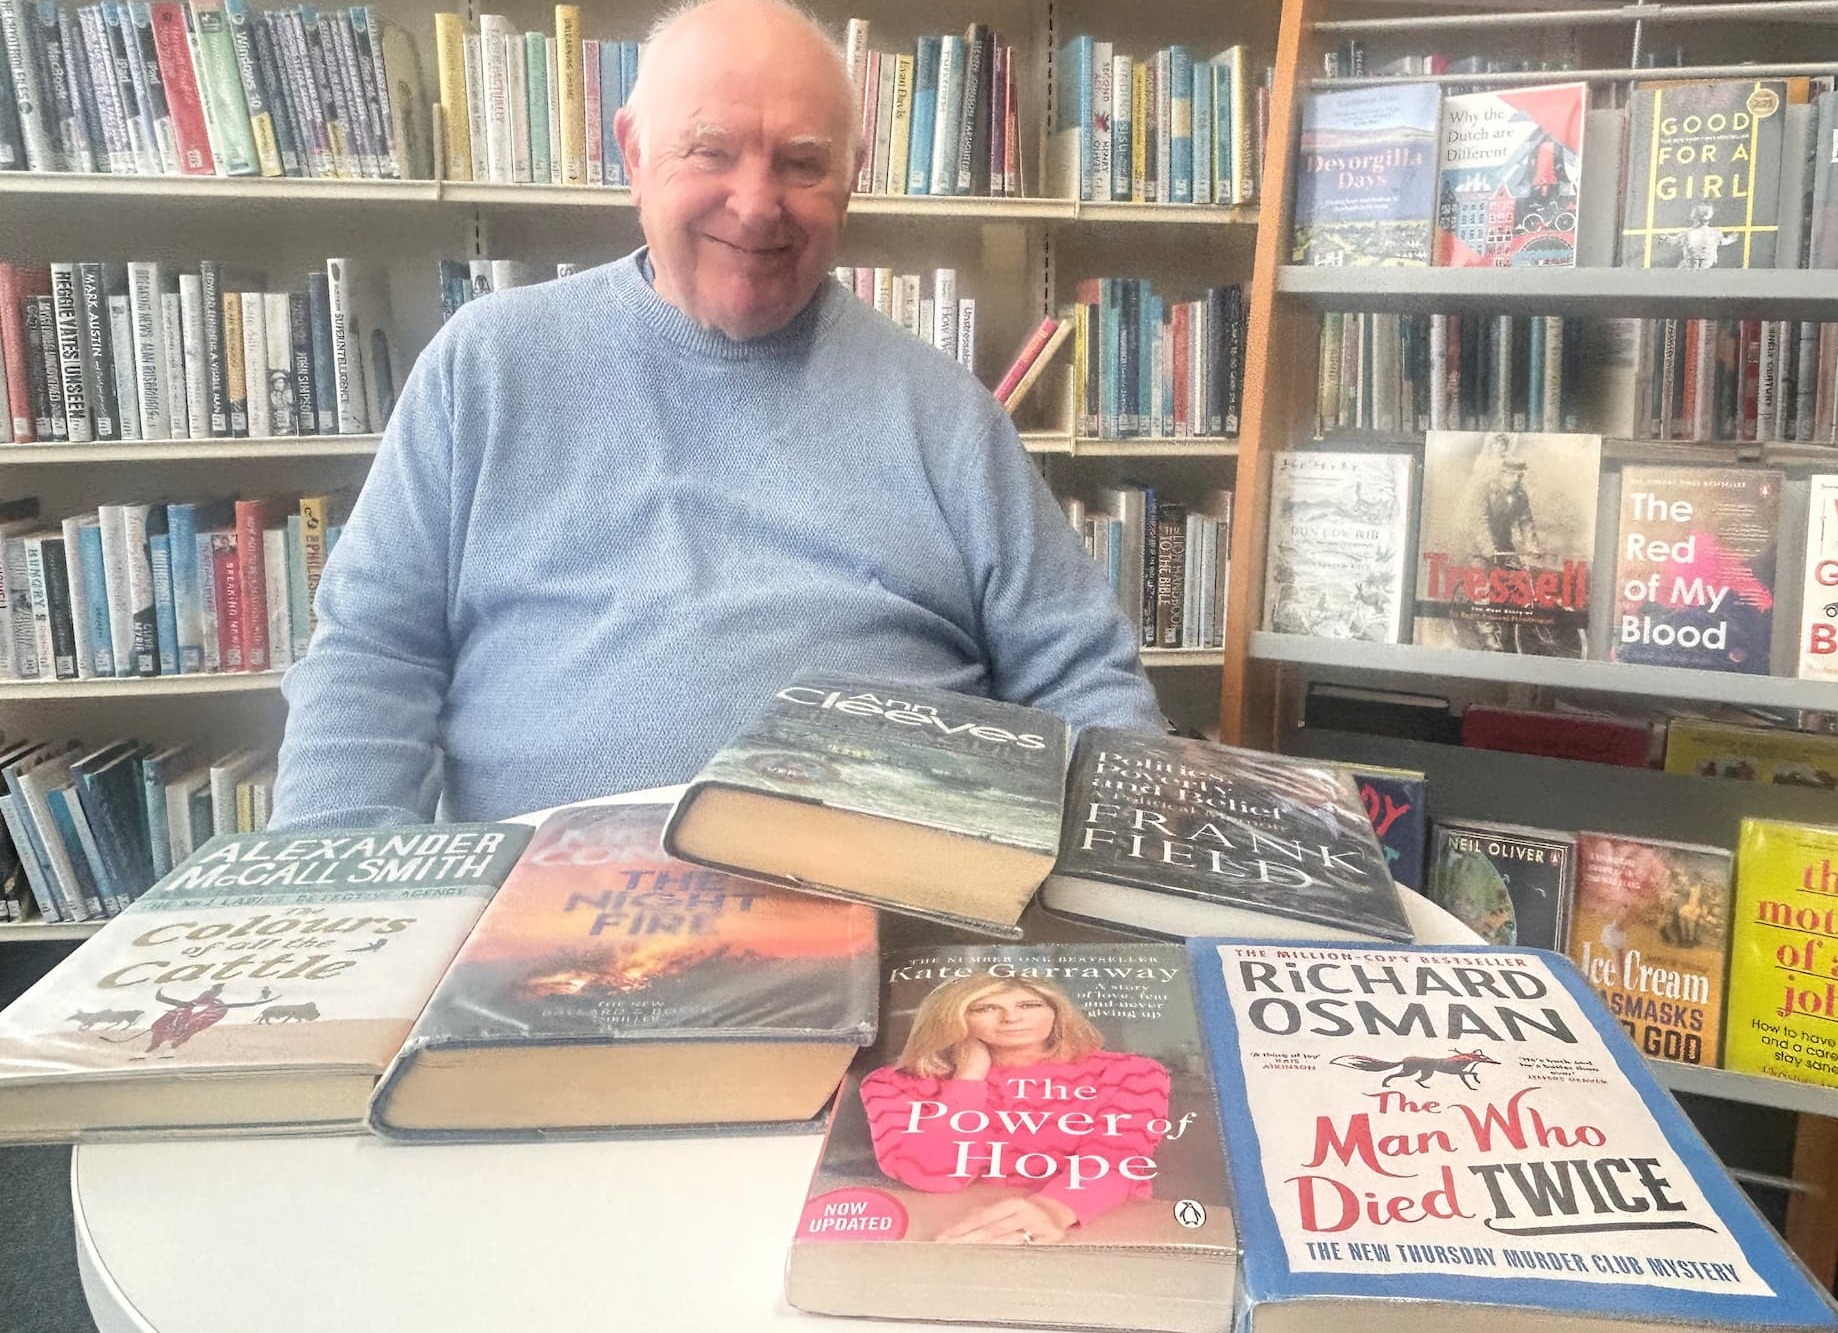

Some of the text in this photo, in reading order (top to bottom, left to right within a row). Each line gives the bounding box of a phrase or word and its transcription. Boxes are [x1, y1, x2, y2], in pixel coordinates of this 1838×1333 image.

[47, 42, 66, 100] MacBook
[235, 31, 254, 90] Windows
[896, 60, 910, 120] Evan Davis
[1451, 107, 1505, 128] Why the
[1660, 112, 1750, 136] GOOD
[1448, 127, 1515, 144] Dutch are
[1307, 147, 1424, 175] Devorgilla
[1447, 147, 1508, 162] Different
[1658, 142, 1750, 165] FOR A
[1337, 171, 1388, 190] Days
[1656, 173, 1749, 201] GIRL
[84, 273, 97, 308] MARK
[88, 312, 103, 357] AUSTIN
[941, 306, 952, 333] How
[211, 352, 218, 360] A
[335, 313, 350, 404] SUPERINTELLIGENCE
[65, 365, 86, 420] UNSEEN
[1631, 492, 1694, 523] The
[1173, 536, 1184, 562] LION
[1626, 532, 1697, 564] Red
[27, 548, 45, 608] HUNGRY
[1159, 536, 1171, 605] TO THE BIBLE
[1424, 551, 1589, 611] Tressell
[225, 562, 237, 616] BREAKING
[1624, 573, 1729, 613] of My
[135, 622, 144, 651] MYRIE
[1621, 615, 1728, 650] Blood
[776, 686, 1046, 750] Cleeves
[849, 693, 938, 715] Ann
[198, 833, 505, 864] ALEXANDER
[1085, 802, 1368, 875] FRANK
[1449, 837, 1545, 863] NEIL OLIVER
[165, 854, 495, 891] McCALL SMITH
[1081, 827, 1315, 888] FIELD
[619, 870, 730, 892] THE
[563, 890, 769, 913] NIGHT
[132, 914, 417, 948] Colours
[180, 936, 337, 958] of all the
[1234, 949, 1528, 967] THE MILLION-COPY BESTSELLER
[1776, 939, 1824, 970] of
[96, 953, 357, 990] Cattle
[889, 963, 1180, 984] Kate Garraway
[1582, 941, 1709, 1005] Ice Cream
[1111, 984, 1150, 993] story
[1086, 1009, 1161, 1019] giving up
[1248, 997, 1578, 1044] OSMAN
[1600, 989, 1704, 1031] ASMASKS
[1643, 1025, 1702, 1065] GOD
[1752, 1019, 1837, 1049] How to have
[1761, 1036, 1789, 1049] and
[1793, 1043, 1802, 1053] a
[1774, 1051, 1838, 1075] stay sane
[1006, 1077, 1098, 1100] The
[1361, 1091, 1442, 1114] The
[904, 1100, 1197, 1141] Power of
[1301, 1087, 1607, 1178] Man Who
[947, 1140, 1160, 1191] Hope
[823, 1202, 869, 1217] NOW
[1284, 1158, 1688, 1232] Died TWICE
[808, 1216, 893, 1234] UPDATED
[1305, 1242, 1742, 1284] THE NEW THURSDAY MURDER CLUB MYSTERY
